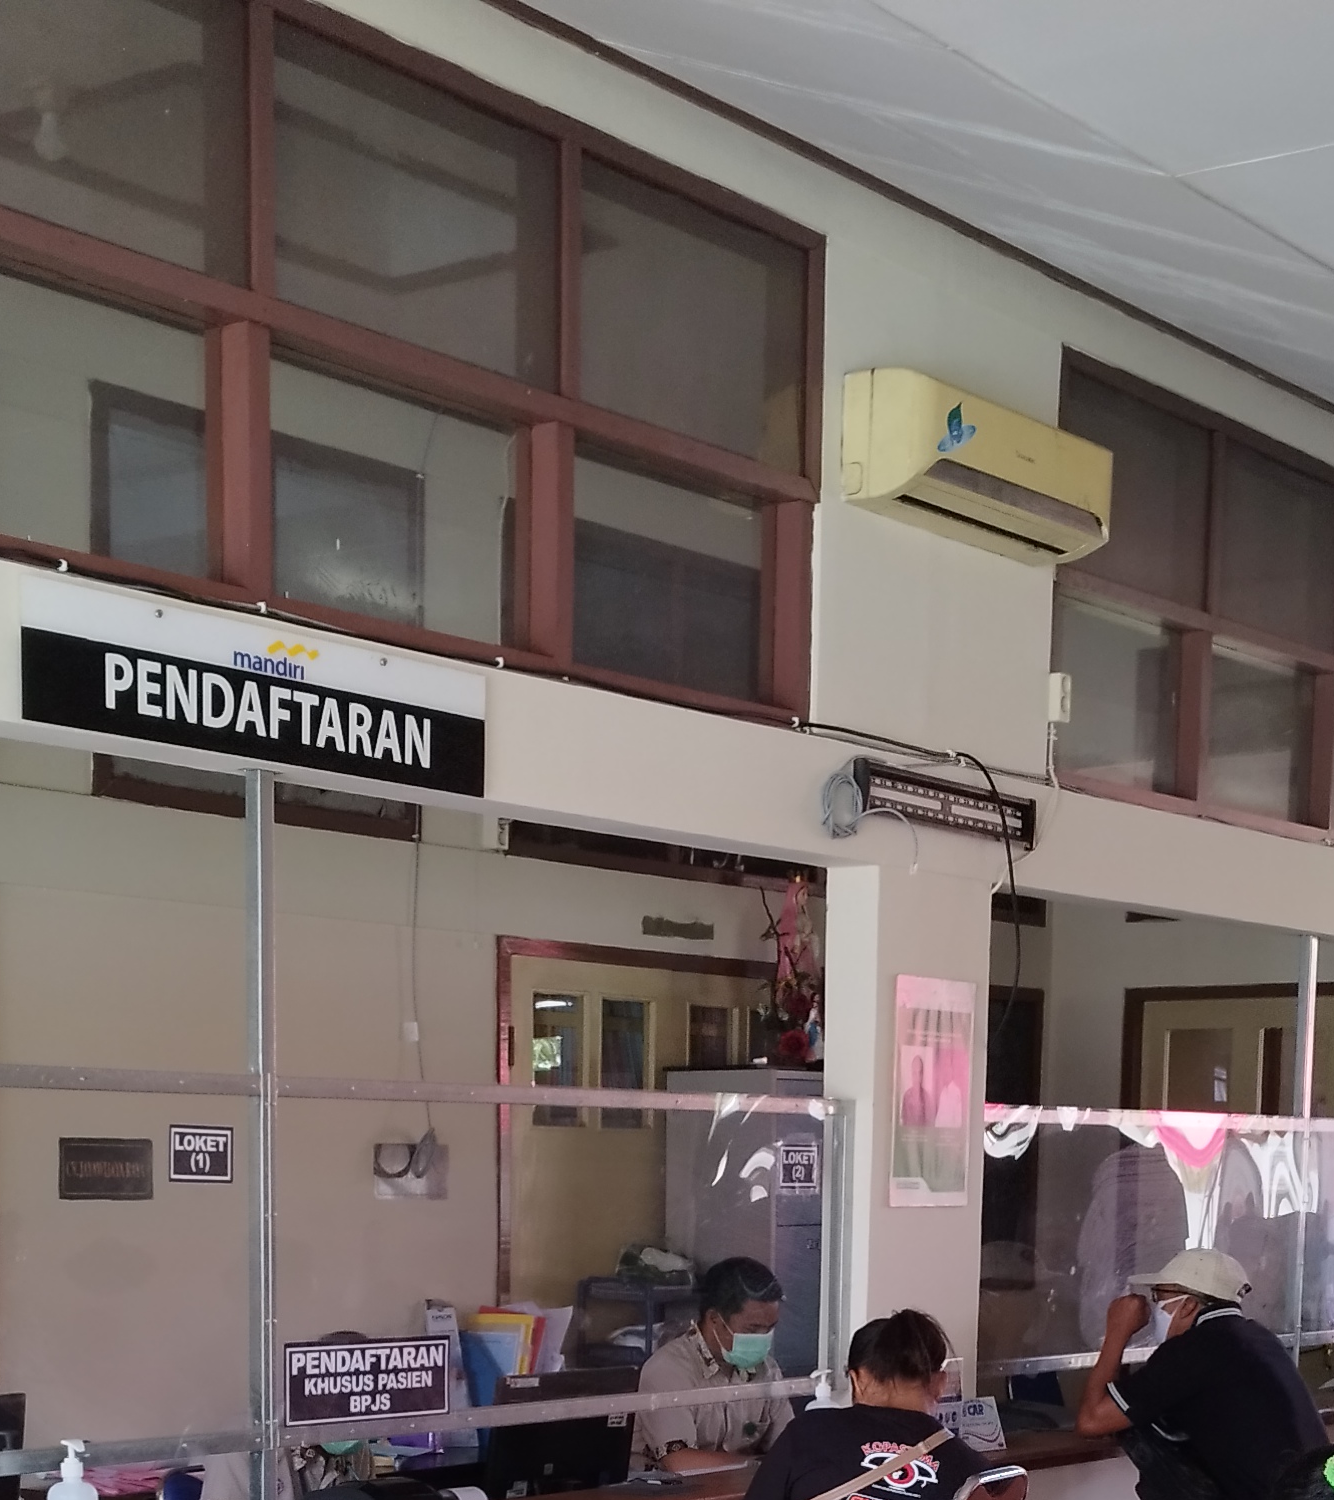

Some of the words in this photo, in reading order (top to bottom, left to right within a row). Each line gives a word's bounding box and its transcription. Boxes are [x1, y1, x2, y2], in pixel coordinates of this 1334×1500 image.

[233, 650, 305, 681] mandiri
[104, 652, 432, 770] PENDAFTARAN
[174, 1134, 226, 1152] LOKET
[190, 1152, 211, 1173] (1)
[783, 1152, 815, 1164] LOKET
[792, 1165, 805, 1180] (2)
[291, 1345, 443, 1376] PENDAFTARAN
[304, 1374, 374, 1396] KHUSUS
[378, 1371, 433, 1391] PASIEN
[349, 1393, 391, 1413] BPJS
